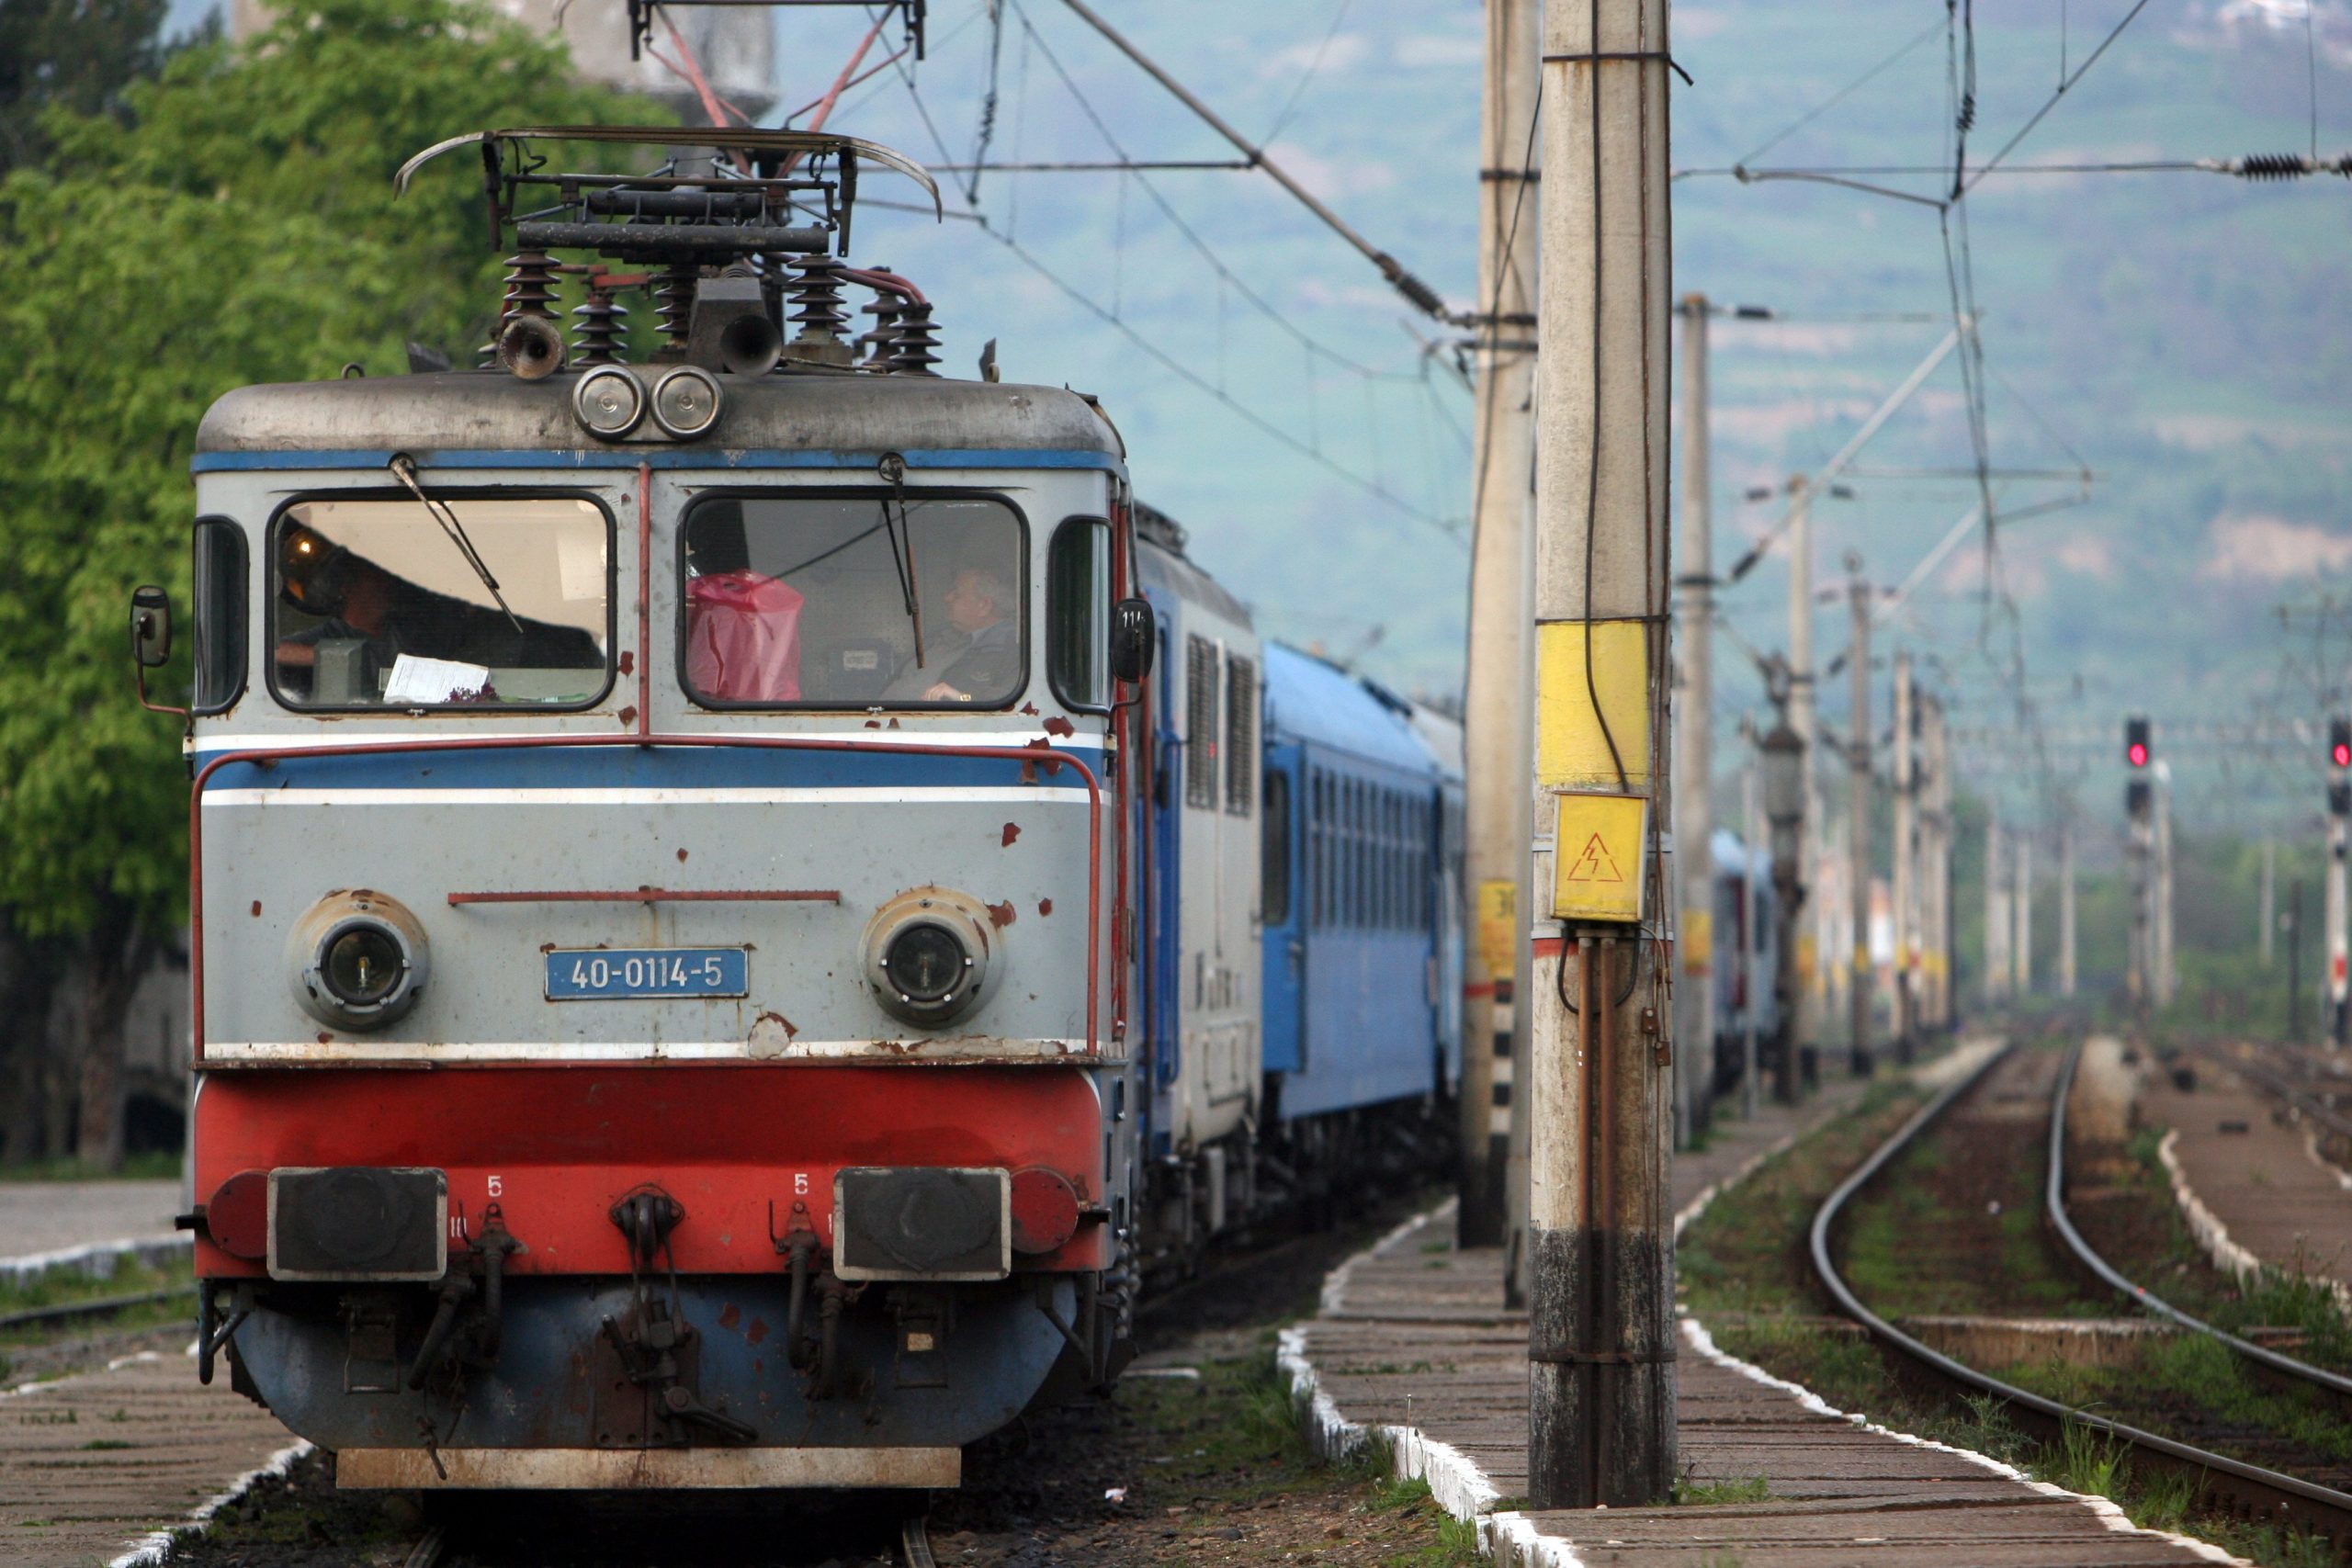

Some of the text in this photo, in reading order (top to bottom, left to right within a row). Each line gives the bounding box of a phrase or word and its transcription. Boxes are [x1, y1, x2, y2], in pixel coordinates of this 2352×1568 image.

[571, 956, 722, 989] 40-0114-5
[488, 1175, 503, 1198] 5
[794, 1173, 808, 1195] 5
